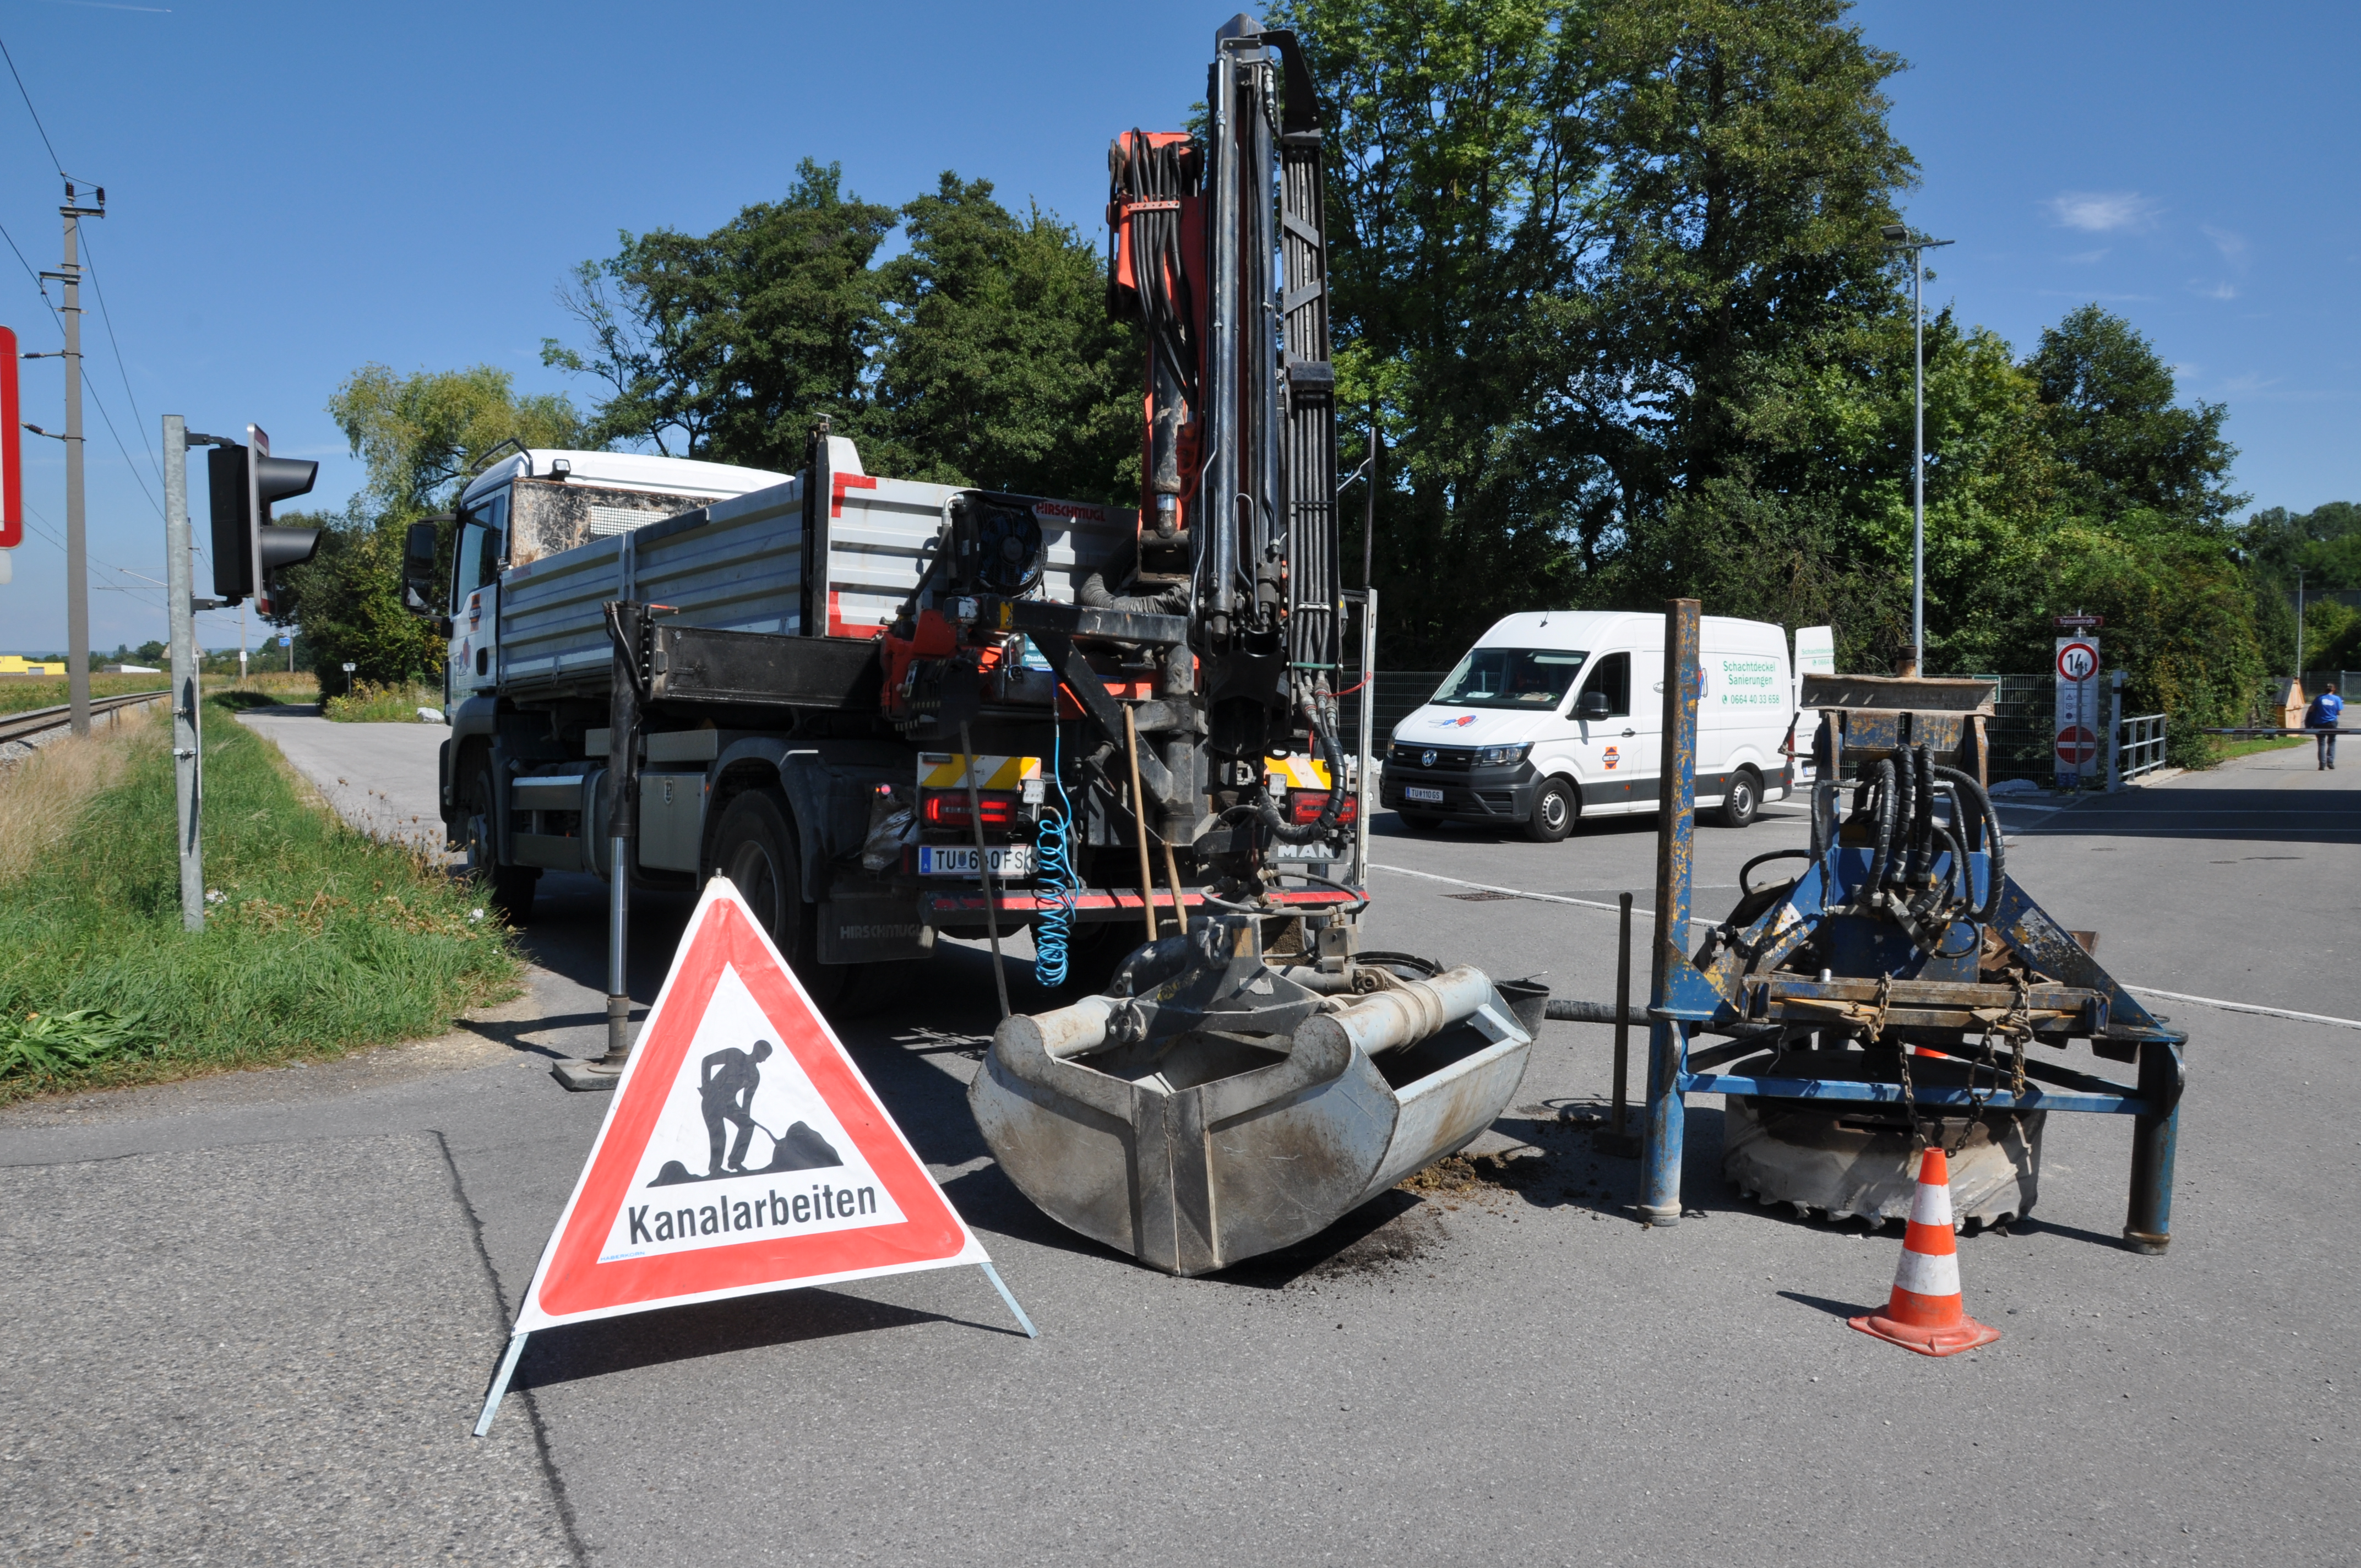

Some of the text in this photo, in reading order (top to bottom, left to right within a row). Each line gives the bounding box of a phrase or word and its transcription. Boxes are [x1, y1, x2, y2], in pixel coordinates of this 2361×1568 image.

[1036, 502, 1106, 521] HIRSCHMUGL
[1723, 660, 1776, 672] Schachtdeckel
[1728, 673, 1773, 687] Sanierungen
[1731, 694, 1780, 704] 0664 40 33 658
[1277, 844, 1334, 858] MAN
[936, 851, 956, 870] TU
[969, 851, 1023, 869] 60FS
[840, 924, 922, 939] HIRSCHMUGL
[628, 1184, 877, 1245] Kanalarbeiten
[600, 1251, 645, 1261] HABERKORN
